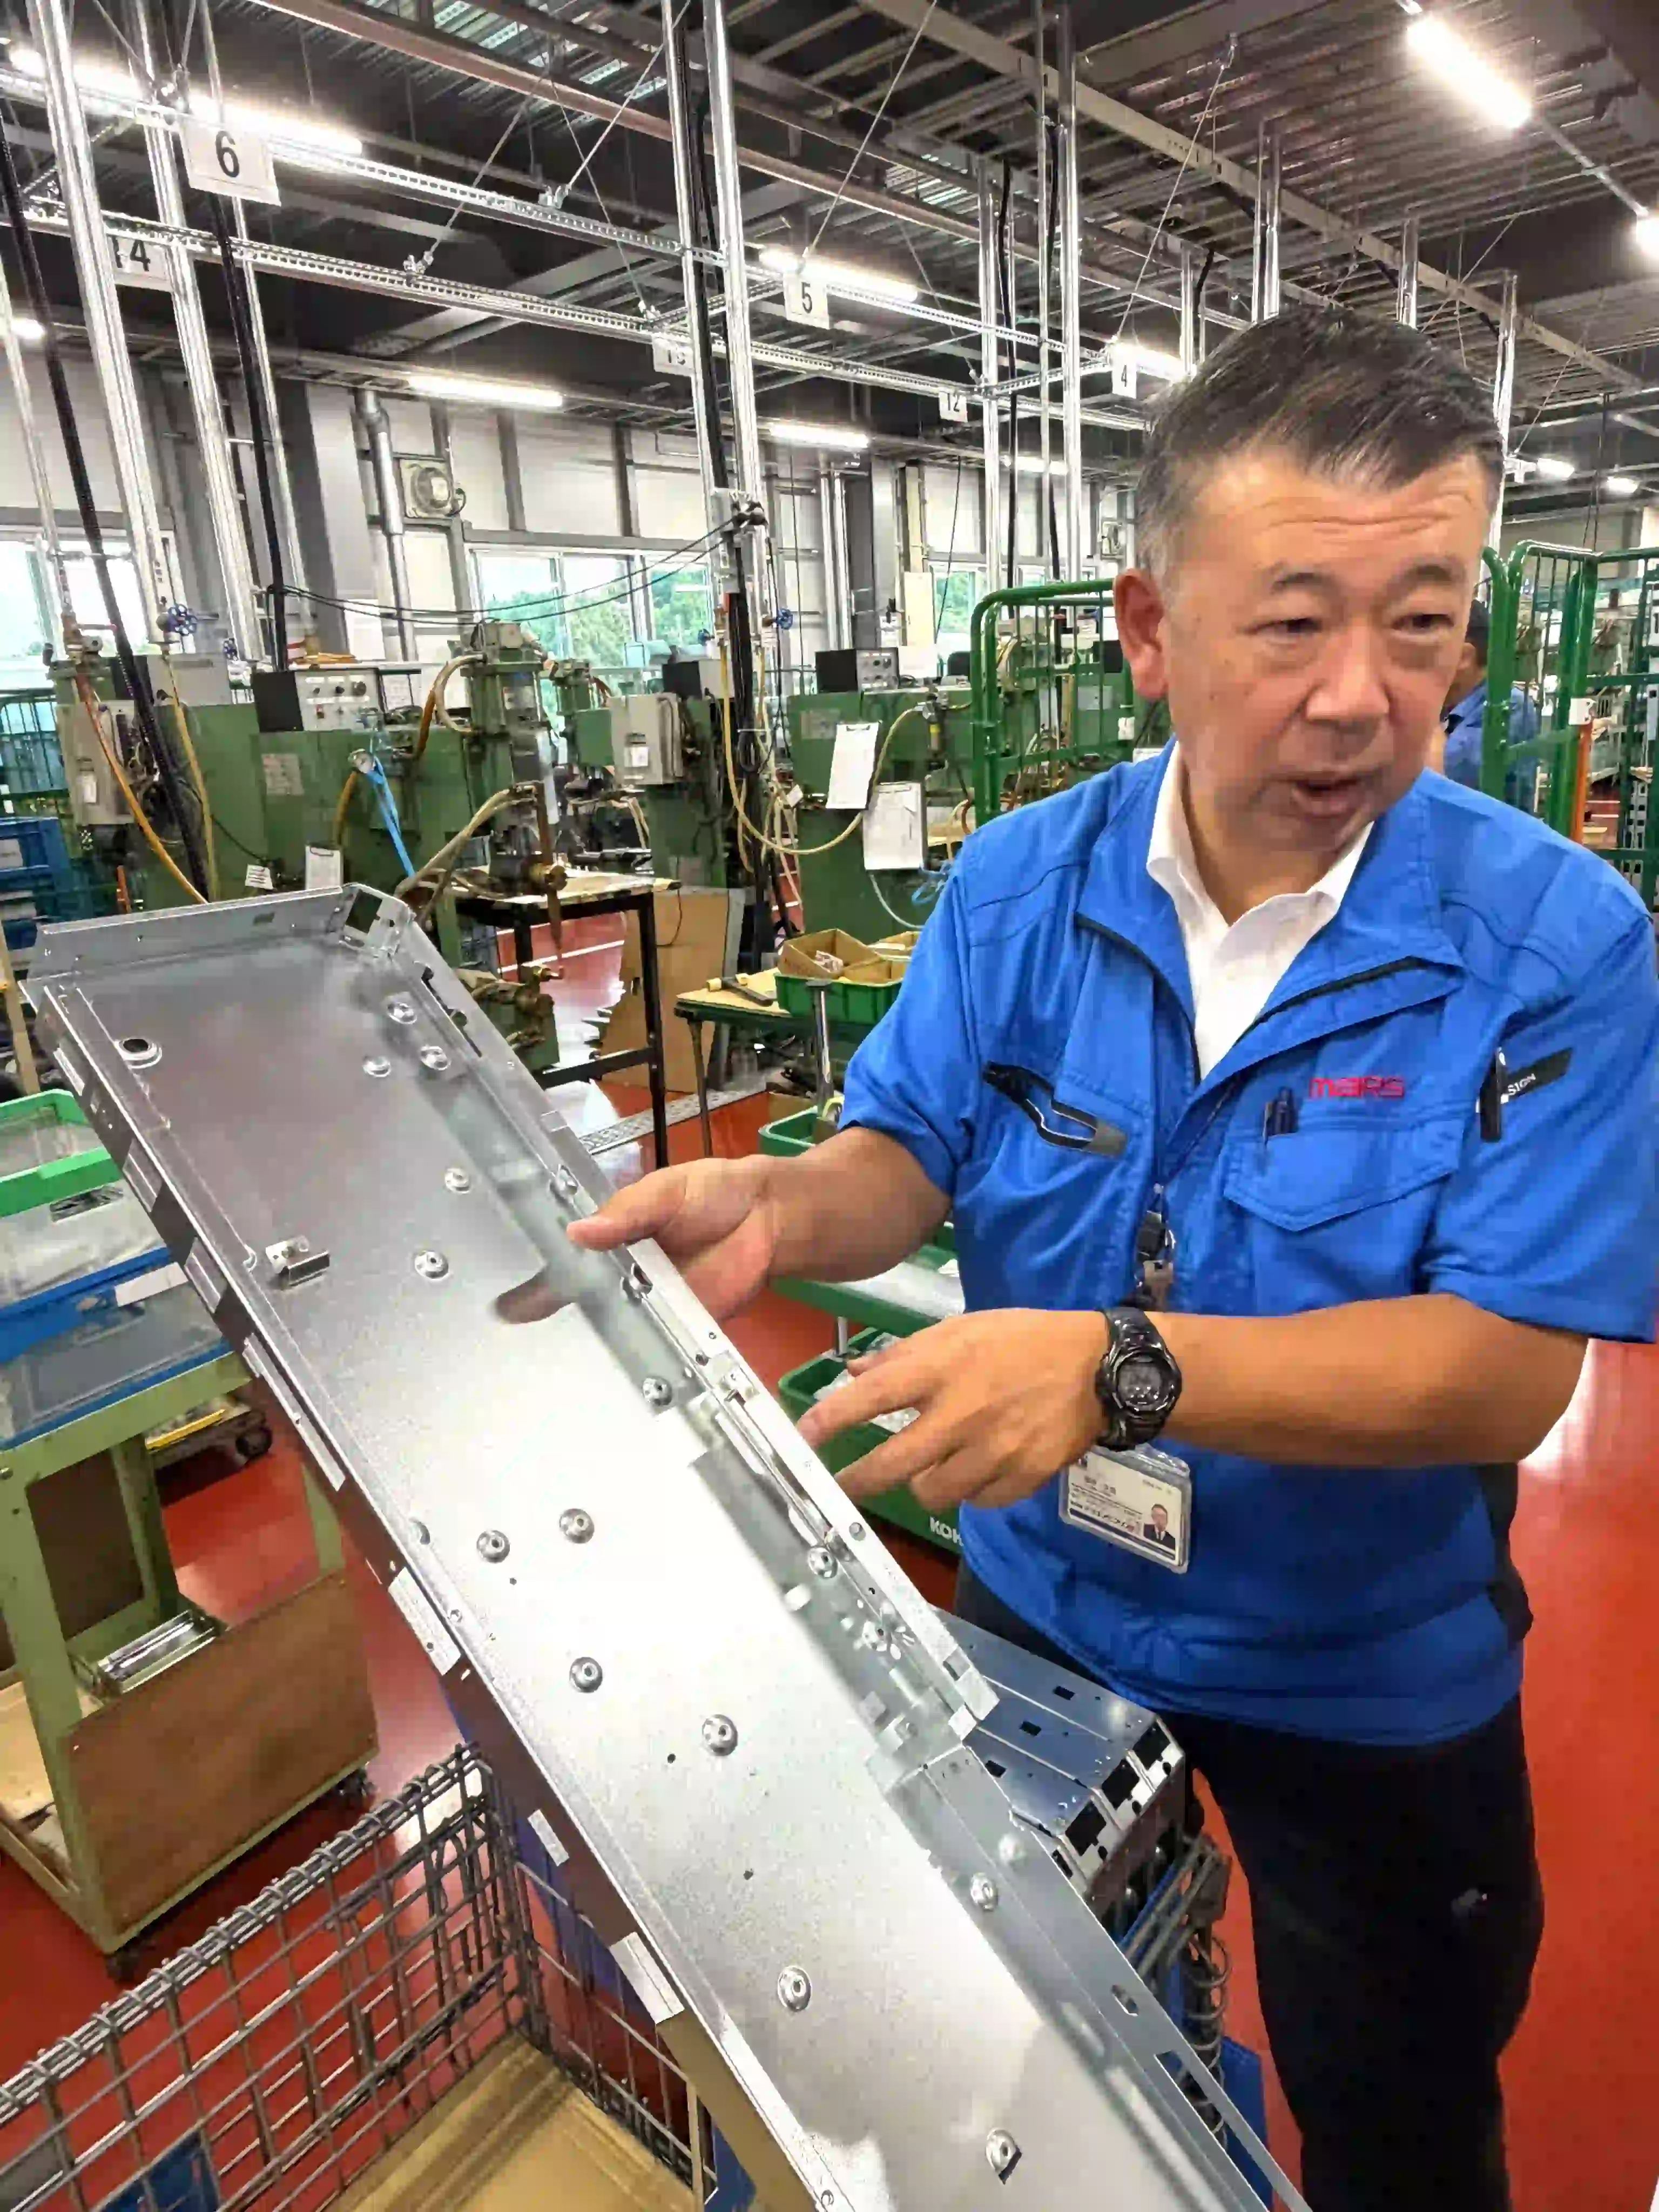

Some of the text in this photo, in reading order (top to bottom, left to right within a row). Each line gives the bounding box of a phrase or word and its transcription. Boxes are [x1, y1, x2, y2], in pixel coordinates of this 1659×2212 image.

[215, 130, 240, 178] 6
[111, 236, 151, 271] 14
[801, 282, 812, 313] 5
[1121, 365, 1127, 387] 4
[947, 393, 960, 412] 12
